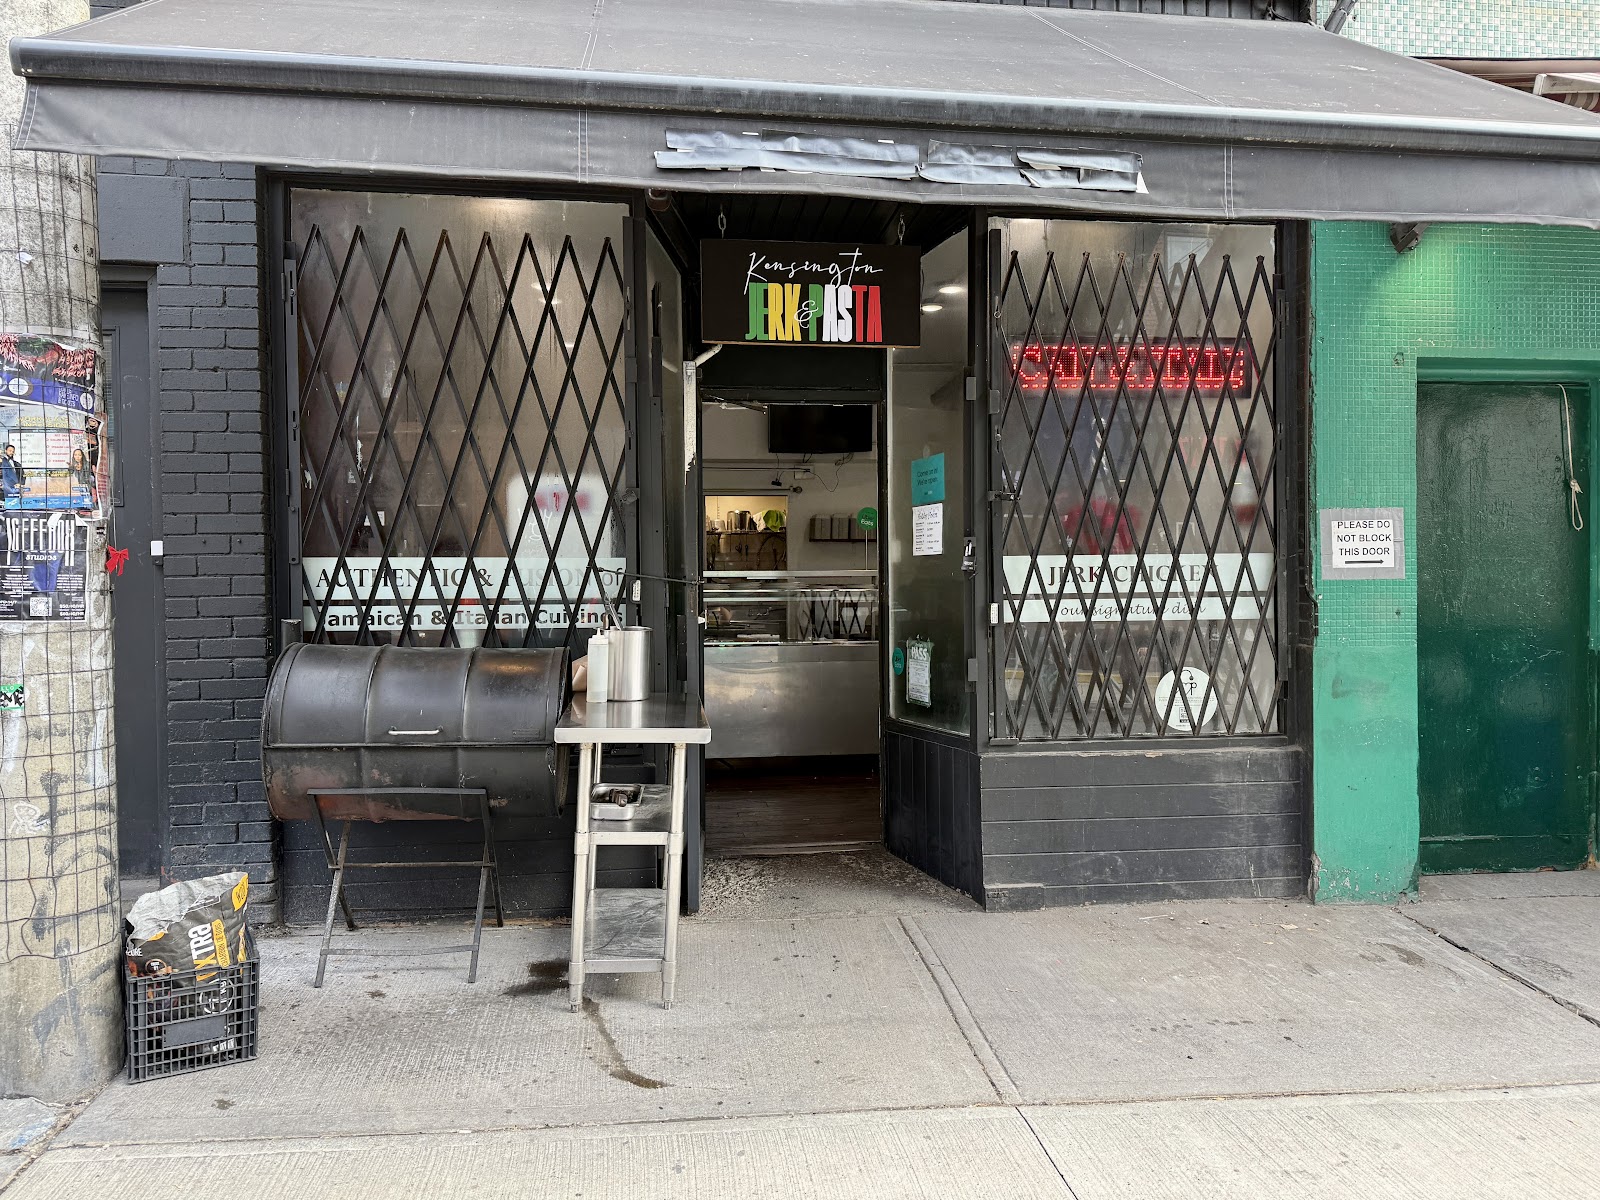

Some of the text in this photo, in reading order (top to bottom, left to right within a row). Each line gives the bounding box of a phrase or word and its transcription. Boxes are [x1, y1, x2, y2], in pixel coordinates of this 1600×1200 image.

[743, 248, 883, 295] Kensington
[745, 282, 883, 342] JERK & PASTA
[1337, 520, 1390, 528] PLEASE DO
[1337, 534, 1392, 542] NOT BLOCK
[1339, 547, 1390, 556] THIS DOOR
[477, 568, 493, 587] &
[602, 567, 622, 586] of
[1113, 564, 1218, 582] CHICE
[319, 608, 623, 626] amaican & Itaian Cuiins
[911, 646, 928, 660] PASS
